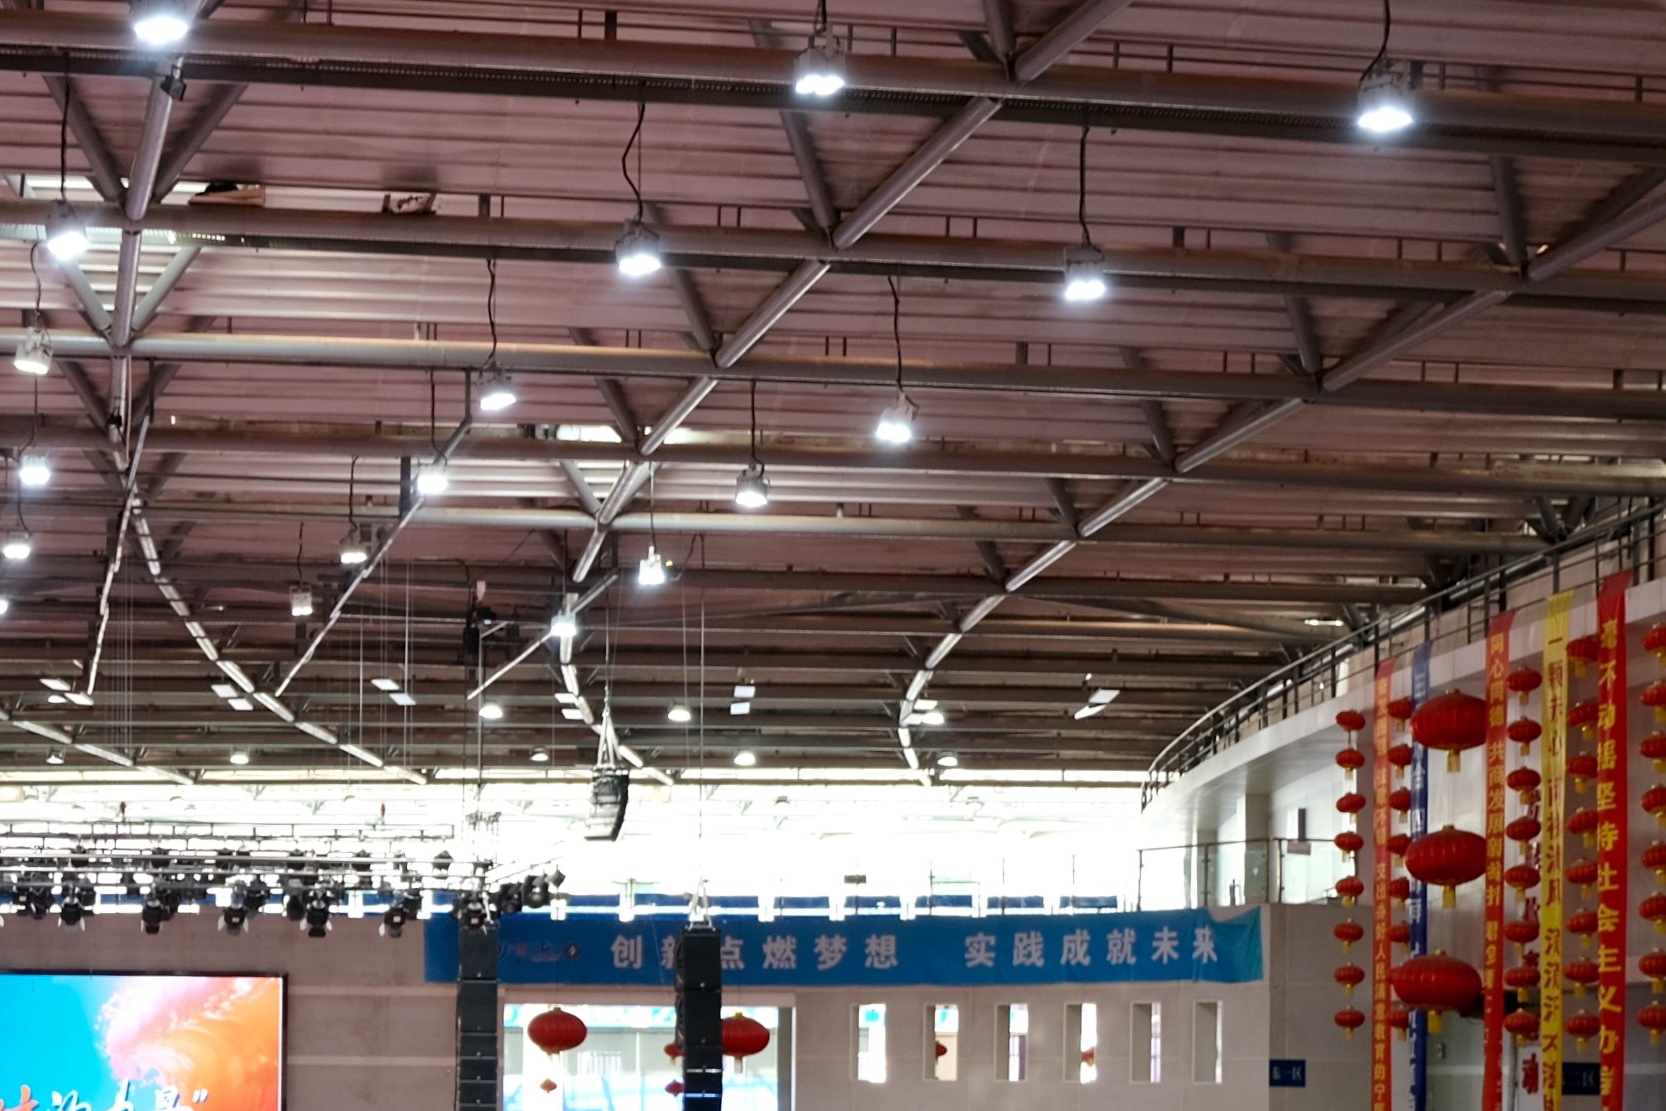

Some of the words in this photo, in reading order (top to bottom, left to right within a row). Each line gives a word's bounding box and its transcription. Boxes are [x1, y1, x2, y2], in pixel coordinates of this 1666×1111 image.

[964, 925, 1218, 968] 实践成就未来
